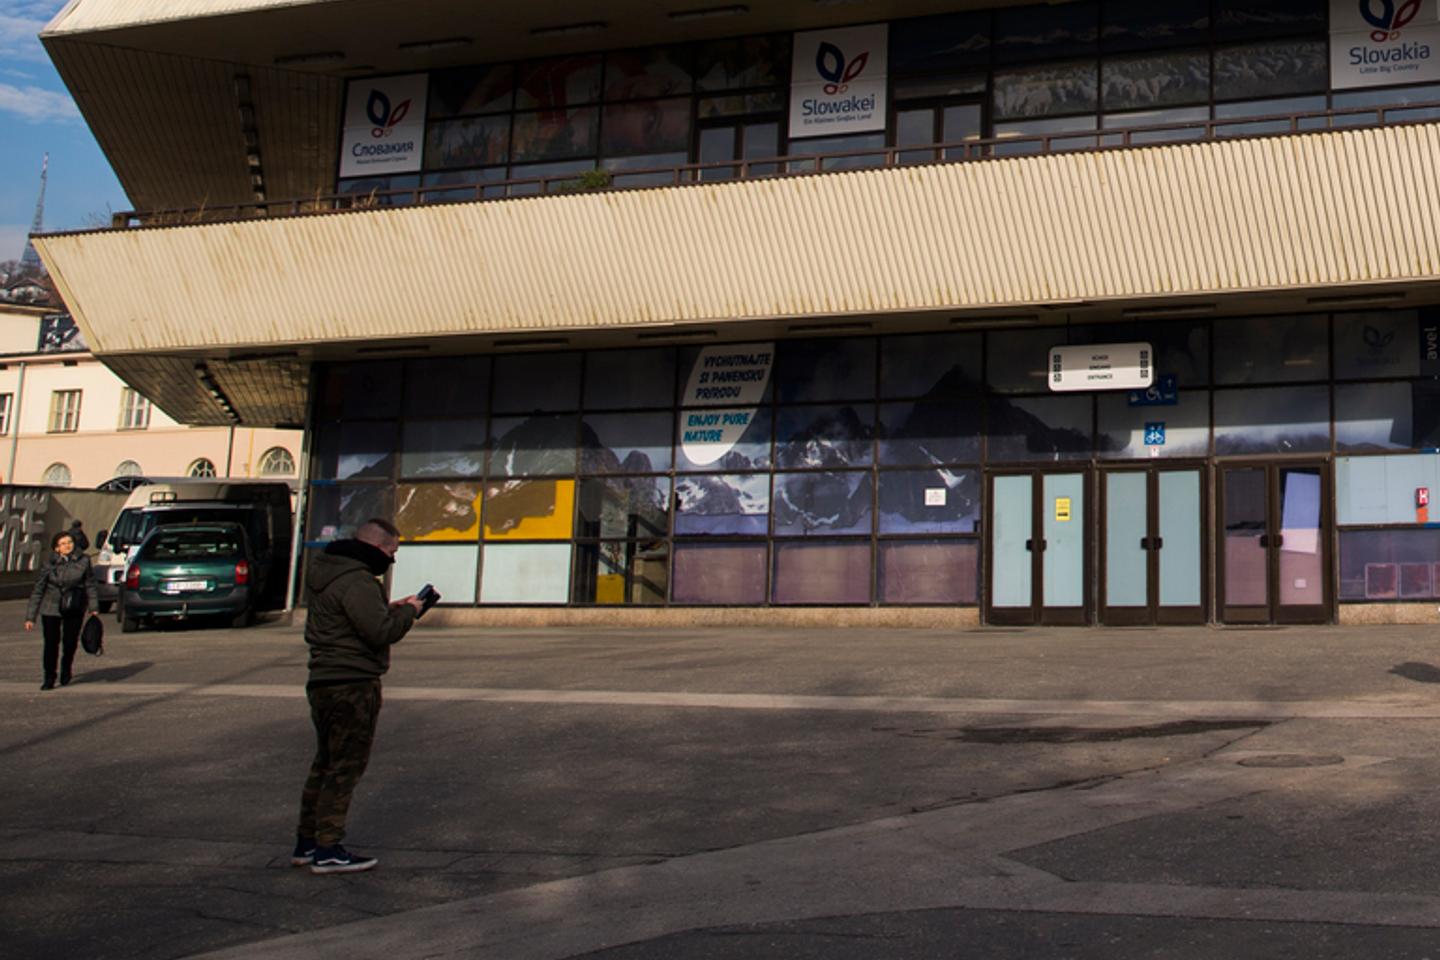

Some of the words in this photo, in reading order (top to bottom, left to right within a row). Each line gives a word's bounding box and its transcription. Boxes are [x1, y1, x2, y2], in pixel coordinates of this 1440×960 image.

[1348, 41, 1431, 66] Slovakia
[802, 93, 875, 116] Slowakei
[687, 414, 721, 427] ENJOY
[722, 413, 751, 425] PURE
[683, 429, 723, 442] NATURE
